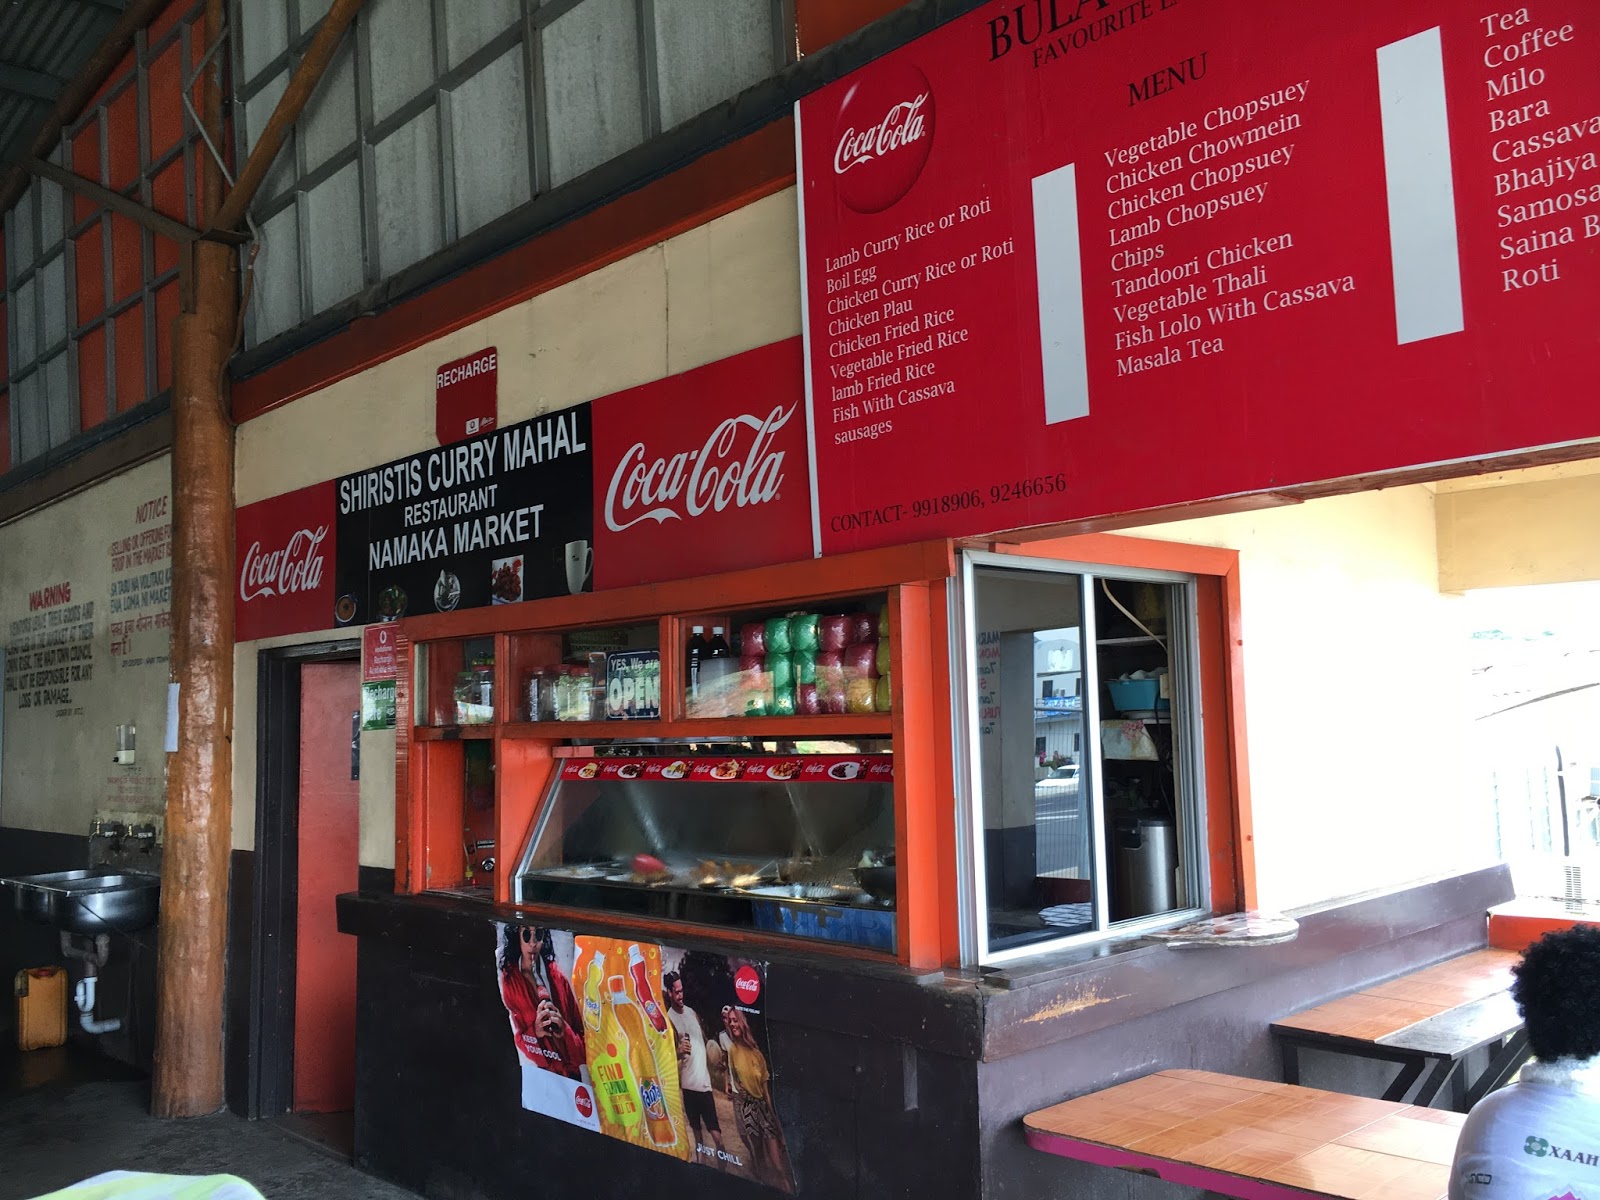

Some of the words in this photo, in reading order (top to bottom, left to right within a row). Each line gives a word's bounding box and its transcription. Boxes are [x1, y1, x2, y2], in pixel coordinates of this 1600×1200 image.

[1031, 0, 1154, 69] FAVOURITE
[1480, 7, 1530, 37] Tea
[1484, 24, 1574, 68] Coffee
[1127, 52, 1208, 107] MENU
[1485, 67, 1545, 101] Milo
[1103, 120, 1198, 168] Vegetable
[1203, 80, 1310, 131] Chopsuey
[1488, 99, 1551, 133] Bara
[1106, 156, 1183, 194] Chicken
[1188, 113, 1302, 164] Chowmein
[1492, 115, 1600, 163] Cassava
[1108, 183, 1184, 220] Chicken
[1190, 143, 1295, 192] Chopsuey
[1494, 152, 1599, 197] Bhajiya
[1109, 215, 1161, 247] Lamb
[1167, 182, 1269, 227] Chopsuey
[1497, 184, 1600, 228] Samosa
[825, 247, 860, 273] Lamb
[863, 233, 902, 258] Curry
[904, 221, 935, 243] Rice
[938, 213, 955, 230] or
[959, 196, 991, 223] Roti
[1500, 226, 1575, 260] Saina
[826, 272, 850, 295] Boil
[853, 264, 877, 286] Egg
[827, 287, 879, 315] Chicken
[882, 271, 921, 296] Curry
[925, 260, 956, 282] Rice
[960, 252, 977, 270] or
[981, 236, 1014, 263] Roti
[1110, 243, 1165, 273] Chips
[1111, 256, 1200, 298] Tandoori
[1206, 232, 1294, 270] Chicken
[1501, 258, 1561, 293] Roti
[1113, 284, 1207, 324] Vegetable
[1212, 264, 1268, 298] Thali
[1114, 325, 1154, 351] Fish
[1158, 313, 1202, 340] Lolo
[1207, 298, 1257, 326] With
[1263, 274, 1356, 311] Cassava
[828, 310, 880, 337] Chicken
[883, 299, 913, 319] Plau
[829, 332, 881, 358] Chicken
[884, 316, 919, 341] Fried
[924, 307, 955, 332] Rice
[436, 353, 497, 389] RECHARGE
[830, 350, 894, 379] Vegetable
[897, 335, 933, 361] Fried
[937, 326, 969, 350] Rice
[1116, 345, 1182, 377] Masala
[1186, 336, 1224, 360] Tea
[831, 381, 864, 402] lamb
[866, 368, 902, 393] Fried
[905, 361, 936, 382] Rice
[832, 402, 859, 423] Fish
[862, 393, 894, 415] With
[898, 379, 956, 406] Cassava
[834, 419, 893, 445] sausages
[340, 458, 423, 515] SHIRISTIS
[427, 435, 498, 493] CURRY
[503, 411, 587, 473] MAHAL
[604, 400, 798, 532] Coca-Cola
[135, 495, 168, 524] NOTICE
[404, 484, 498, 528] RESTAURANT
[831, 504, 908, 533] CONTACT-
[912, 489, 985, 519] 9918906,
[990, 473, 1067, 504] 9246656
[368, 529, 449, 571] NAMAKA
[453, 503, 544, 555] MARKET
[240, 524, 329, 602] Coca-Cola
[29, 581, 71, 612] WARNING
[630, 657, 643, 670] We
[609, 676, 660, 711] OPEN
[522, 1033, 538, 1044] KEEP
[525, 1044, 543, 1056] YOUR
[543, 1049, 562, 1061] COOL
[597, 1063, 624, 1082] FIND
[697, 1142, 715, 1157] JUST
[717, 1150, 743, 1167] CHILL
